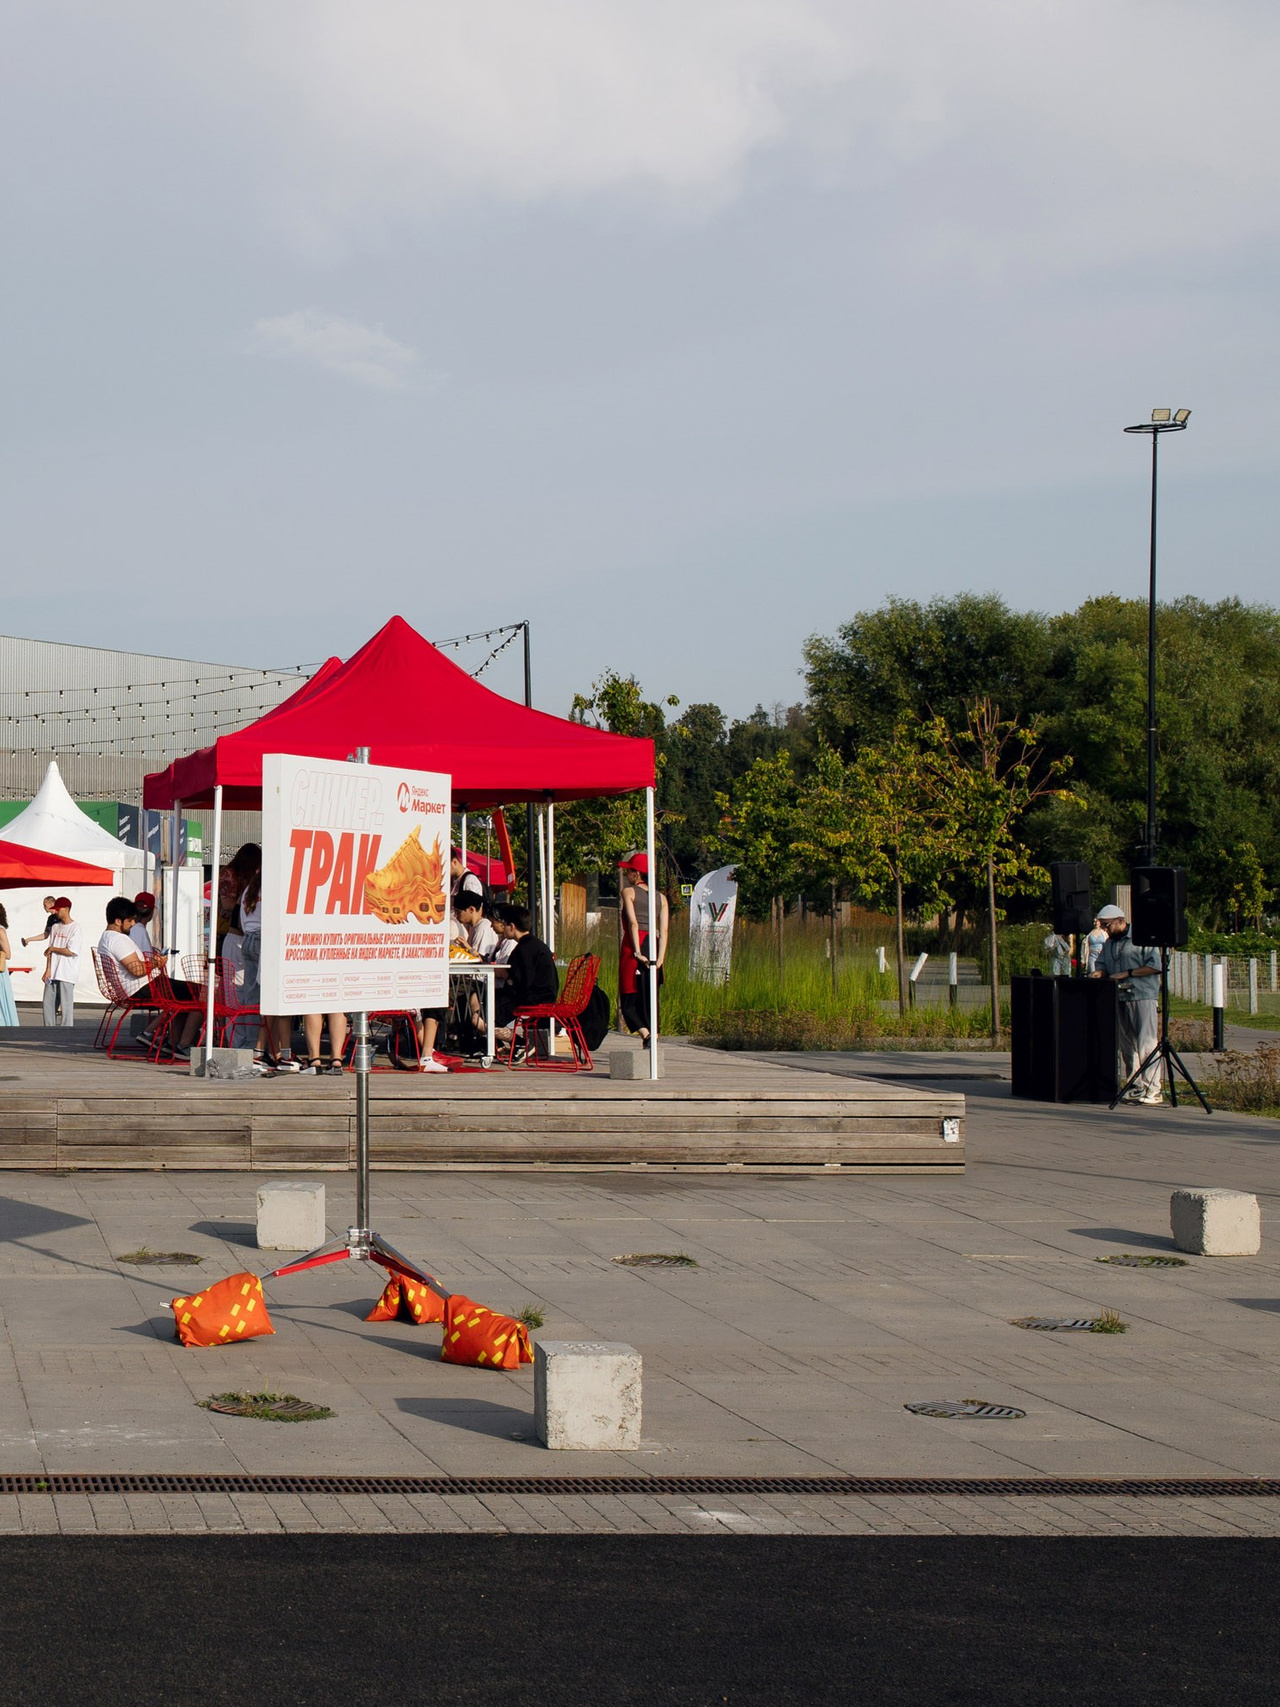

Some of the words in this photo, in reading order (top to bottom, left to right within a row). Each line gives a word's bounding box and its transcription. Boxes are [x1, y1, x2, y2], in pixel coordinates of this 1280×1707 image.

[411, 785, 430, 798] Яндекс
[410, 799, 447, 816] Маркет
[285, 933, 291, 945] У
